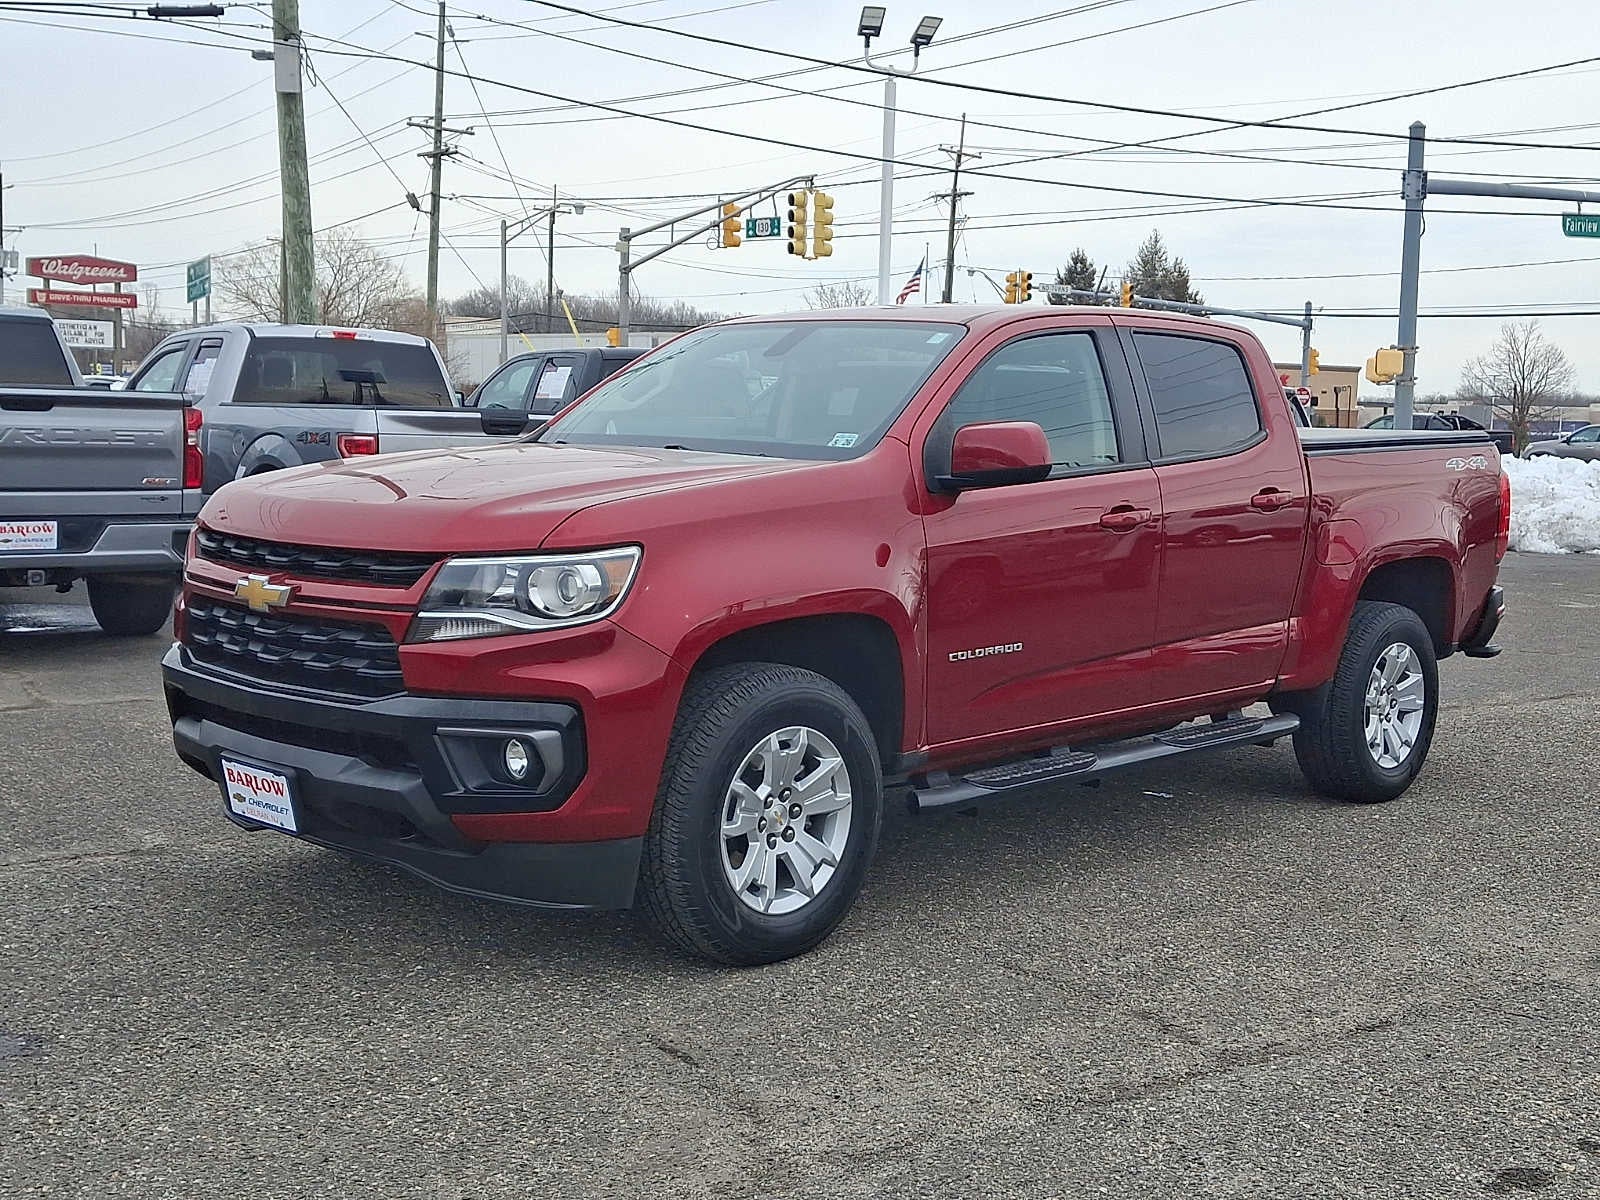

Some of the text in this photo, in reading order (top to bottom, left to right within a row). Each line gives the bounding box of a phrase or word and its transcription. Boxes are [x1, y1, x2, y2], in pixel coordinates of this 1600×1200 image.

[757, 222, 770, 233] 130
[1566, 217, 1598, 232] Fairview
[40, 258, 128, 280] Walgreens
[49, 294, 131, 304] DRIVE-THRU PHARMACY
[0, 525, 54, 536] BARLOW
[948, 642, 1023, 662] COLORADO
[226, 767, 285, 797] BARLOW
[248, 797, 289, 816] CHEVROLET
